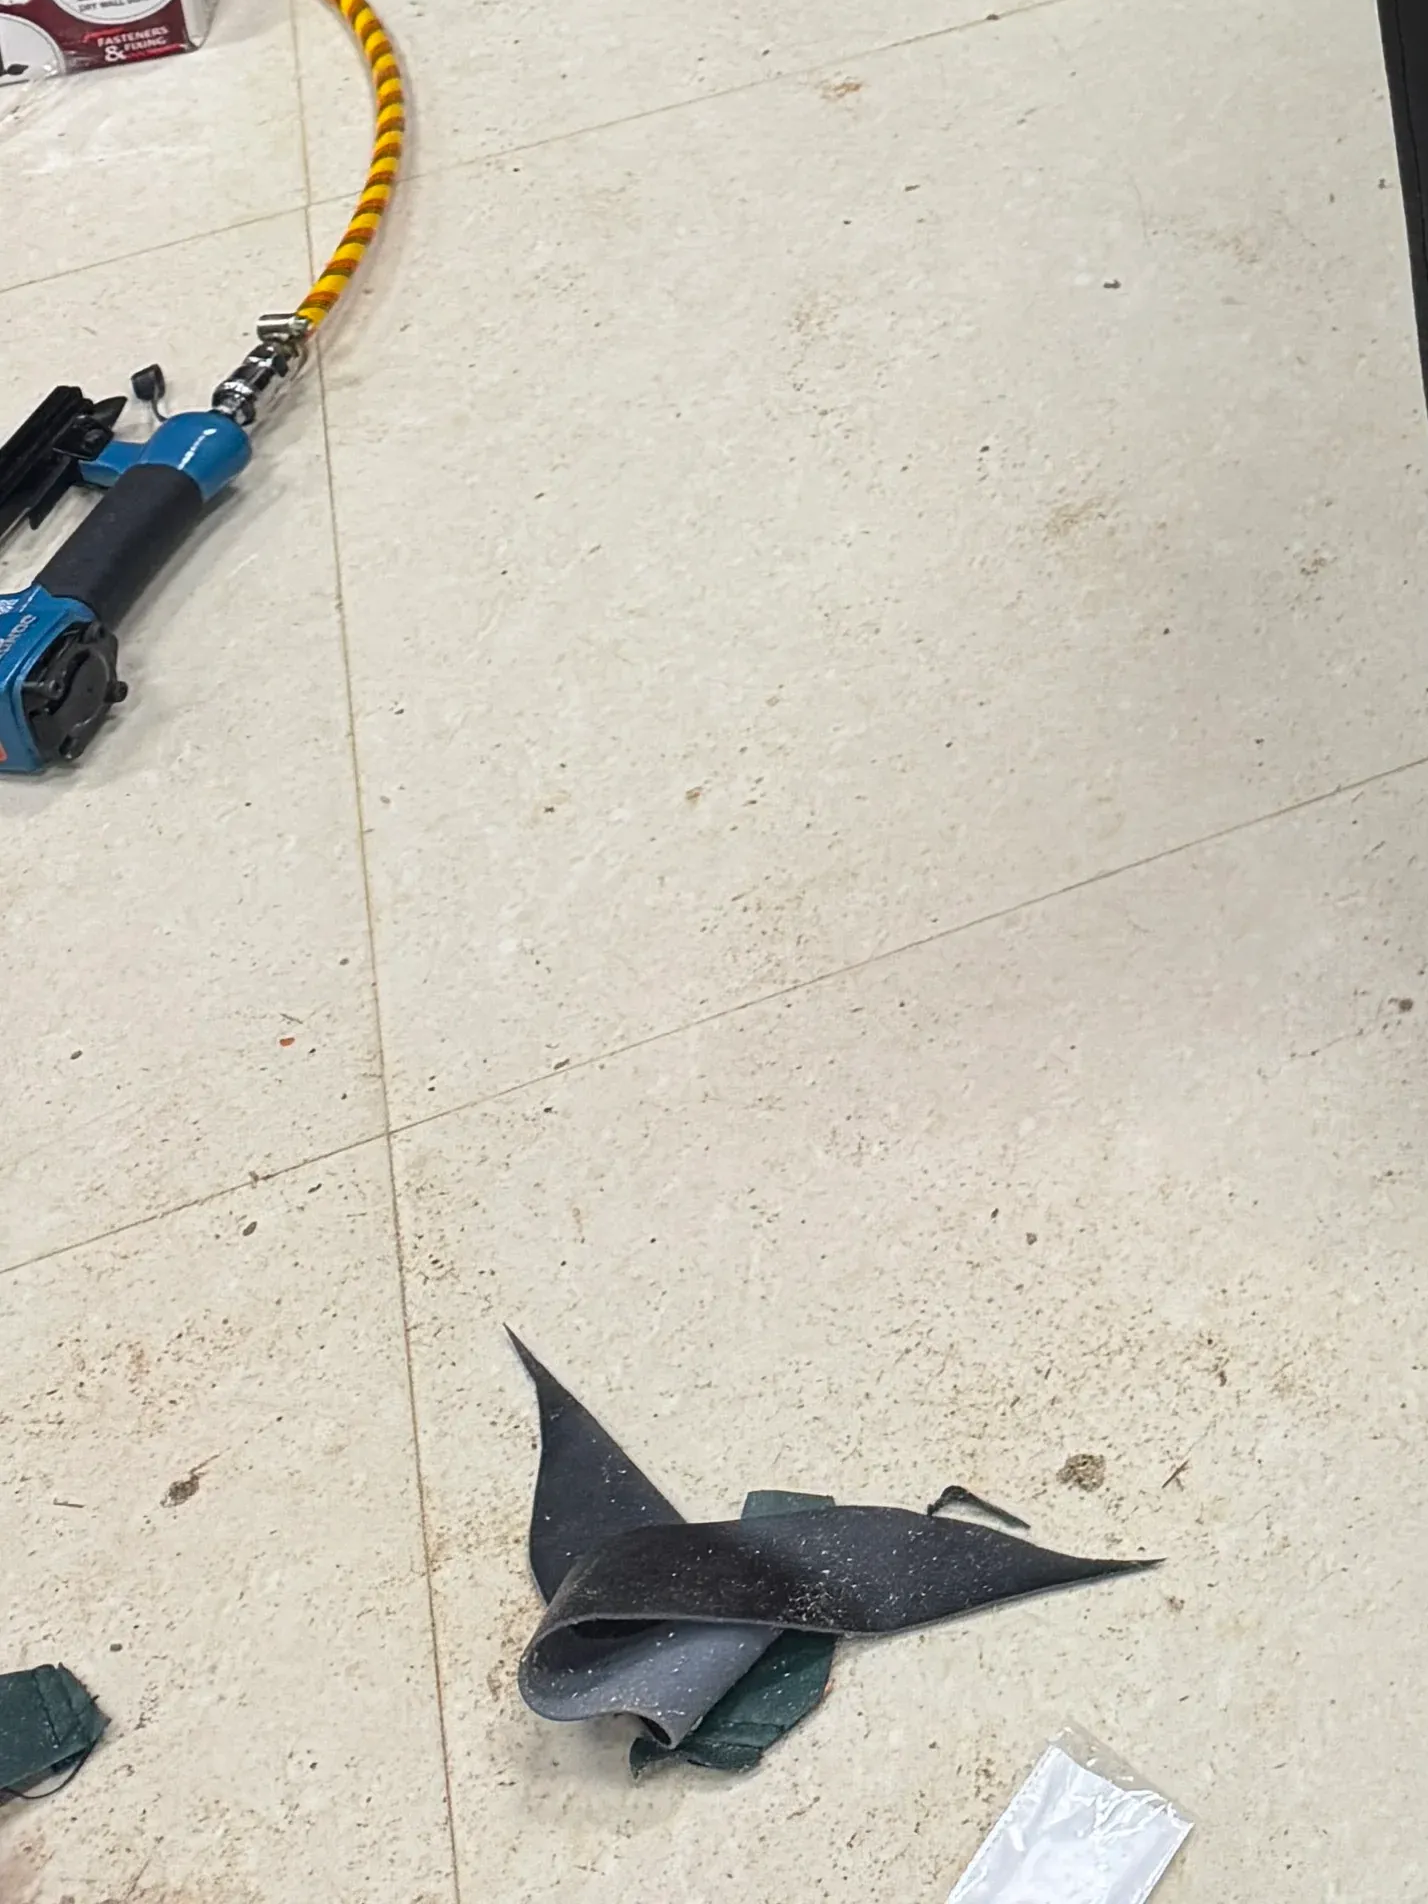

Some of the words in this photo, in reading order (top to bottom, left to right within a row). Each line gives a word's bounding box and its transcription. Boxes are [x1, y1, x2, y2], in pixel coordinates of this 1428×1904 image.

[79, 1, 98, 13] DRY
[97, 26, 169, 47] FASTENERS
[124, 37, 167, 51] FIXING
